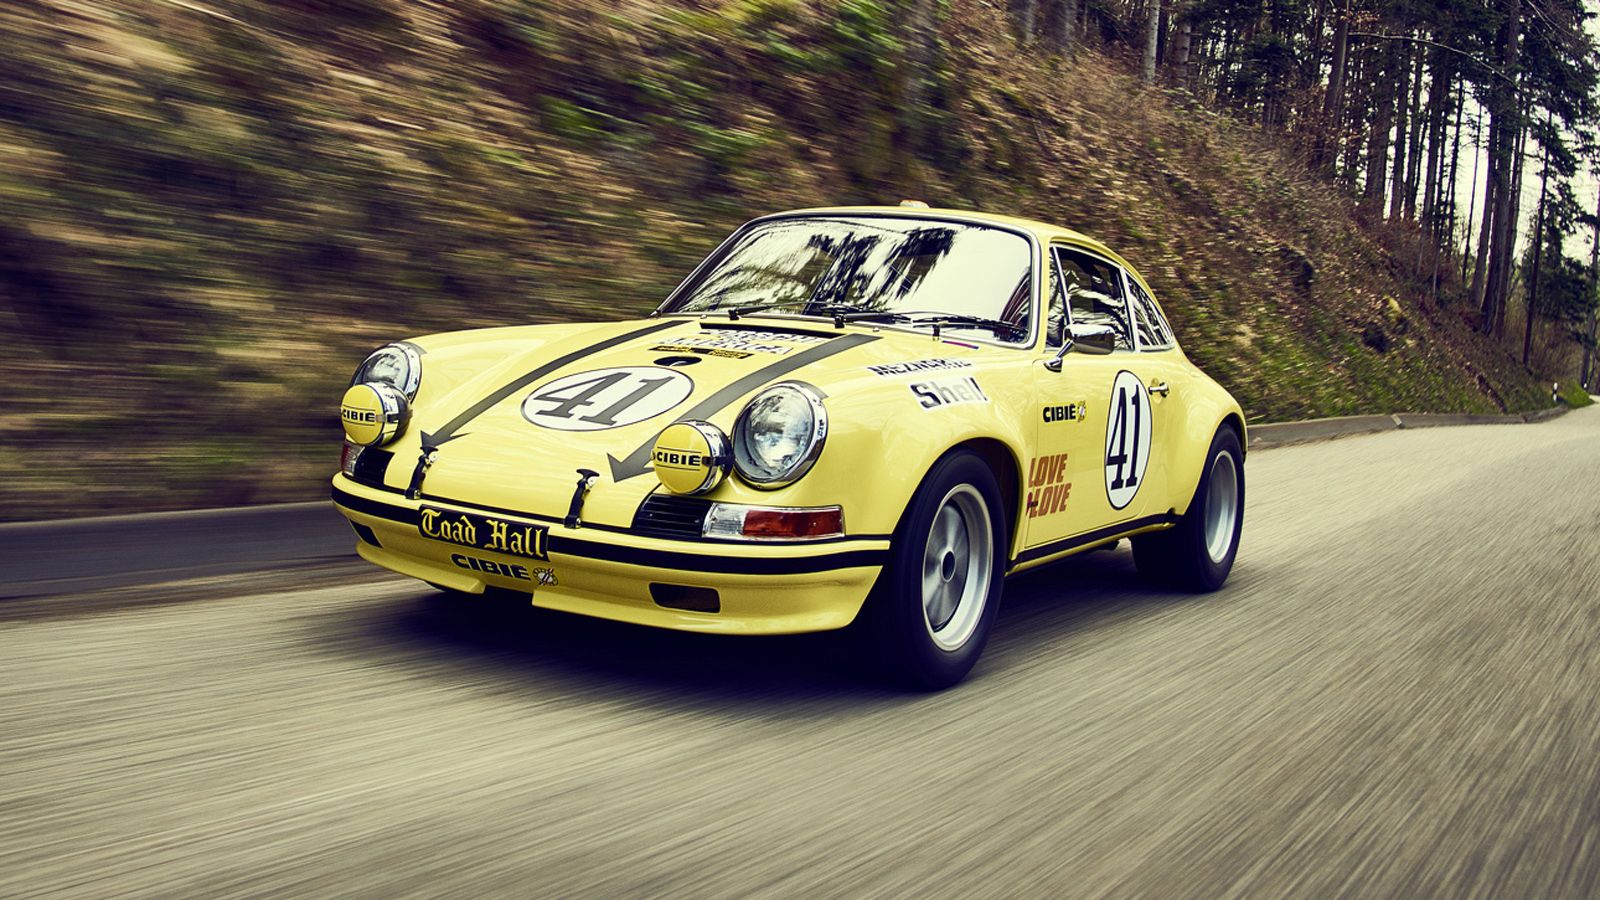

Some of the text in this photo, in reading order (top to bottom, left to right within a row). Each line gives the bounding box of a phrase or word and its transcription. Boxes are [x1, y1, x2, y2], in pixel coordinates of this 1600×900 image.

[533, 371, 676, 426] 41
[910, 377, 988, 409] Shell
[1106, 384, 1140, 491] 41
[1028, 453, 1068, 488] LOVE
[421, 508, 545, 558] Toad Hall
